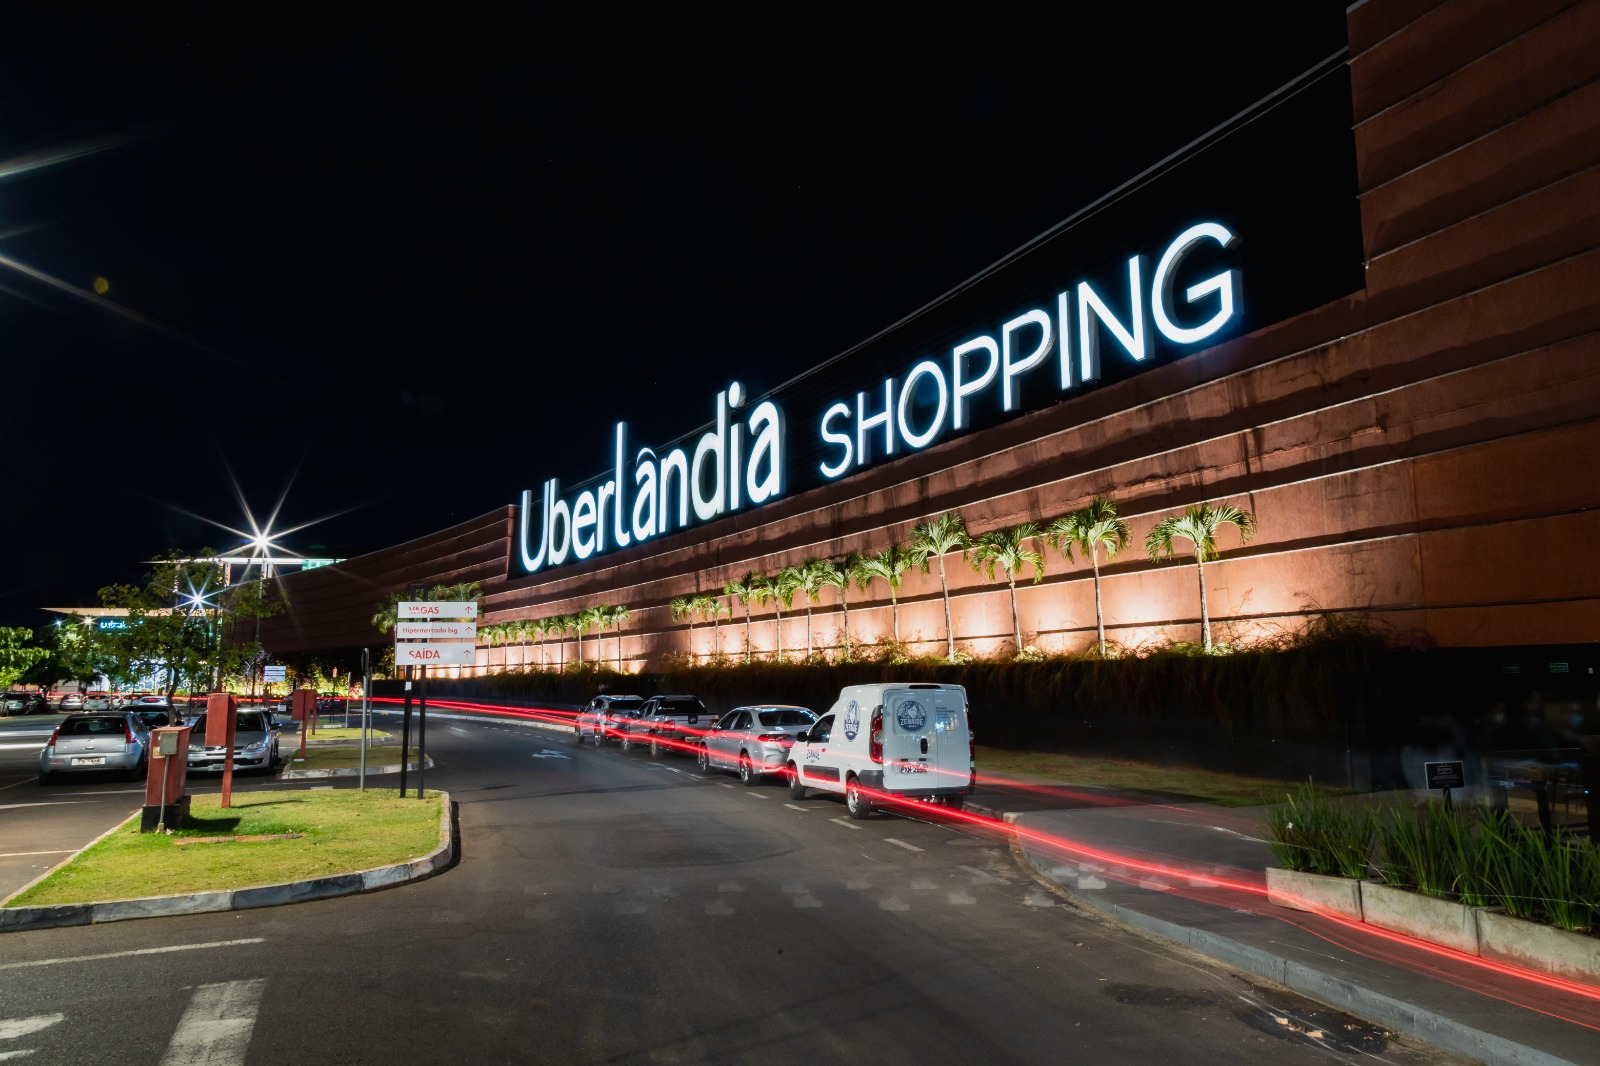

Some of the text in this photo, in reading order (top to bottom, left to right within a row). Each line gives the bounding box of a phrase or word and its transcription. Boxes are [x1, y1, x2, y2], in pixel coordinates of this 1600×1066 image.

[521, 222, 1239, 573] Uberlândia SHOPPING
[408, 648, 440, 659] SAÍDA
